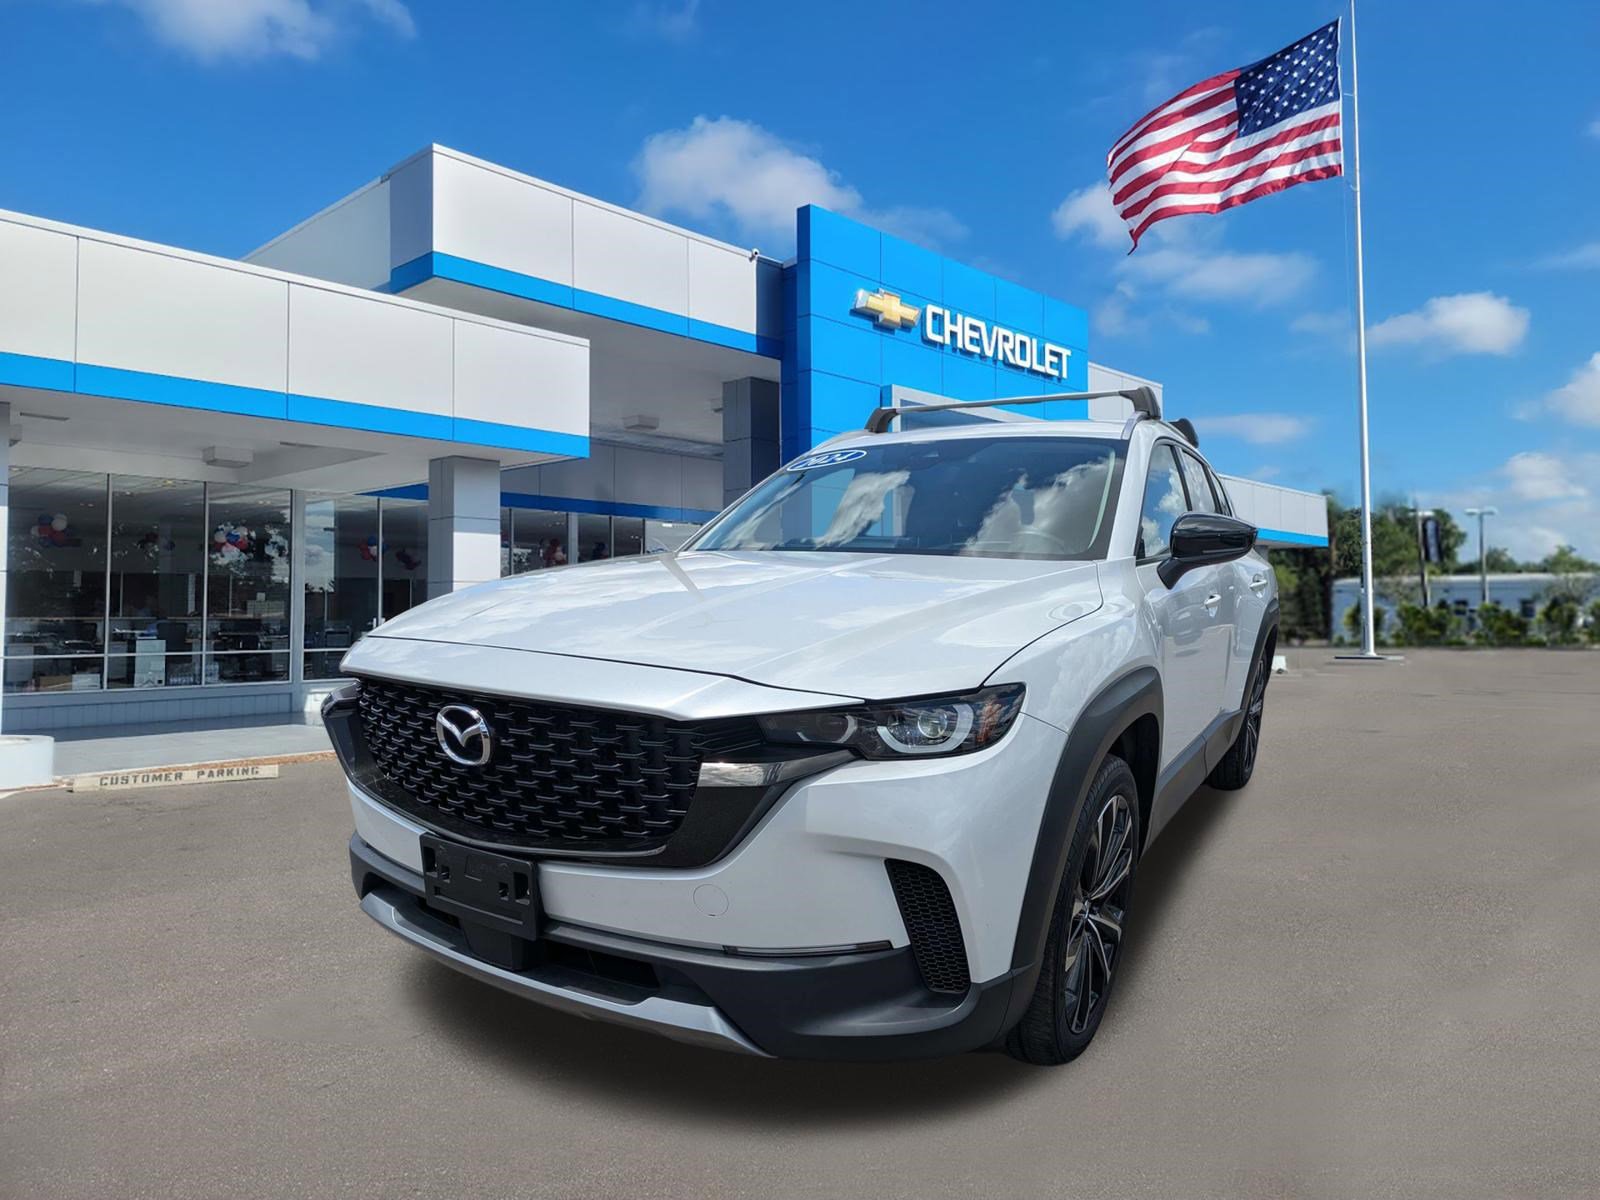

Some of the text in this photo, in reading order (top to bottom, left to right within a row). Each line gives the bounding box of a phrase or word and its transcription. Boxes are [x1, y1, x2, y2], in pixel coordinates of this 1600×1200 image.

[925, 304, 1072, 379] CHEVROLET
[100, 766, 259, 786] CUSTOMER PARKING
